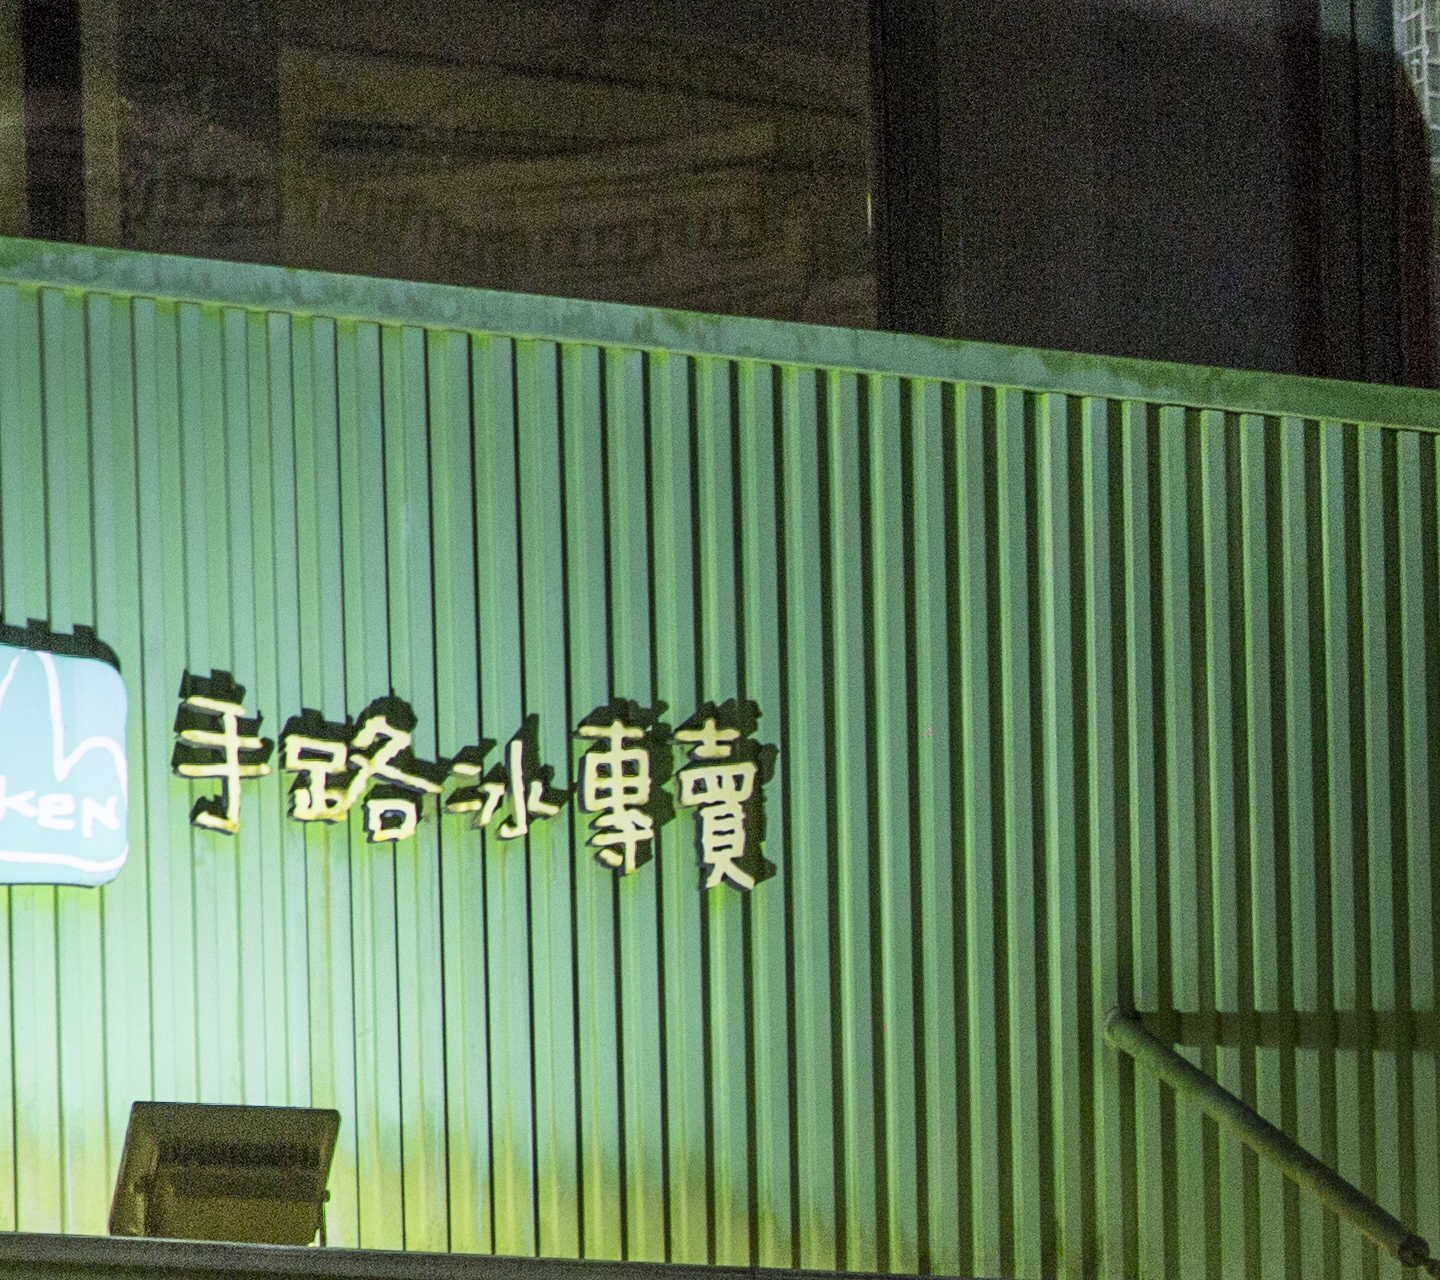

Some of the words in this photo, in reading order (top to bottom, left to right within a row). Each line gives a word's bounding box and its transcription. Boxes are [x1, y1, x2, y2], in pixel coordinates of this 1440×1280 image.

[176, 692, 758, 892] 手路冰專賣
